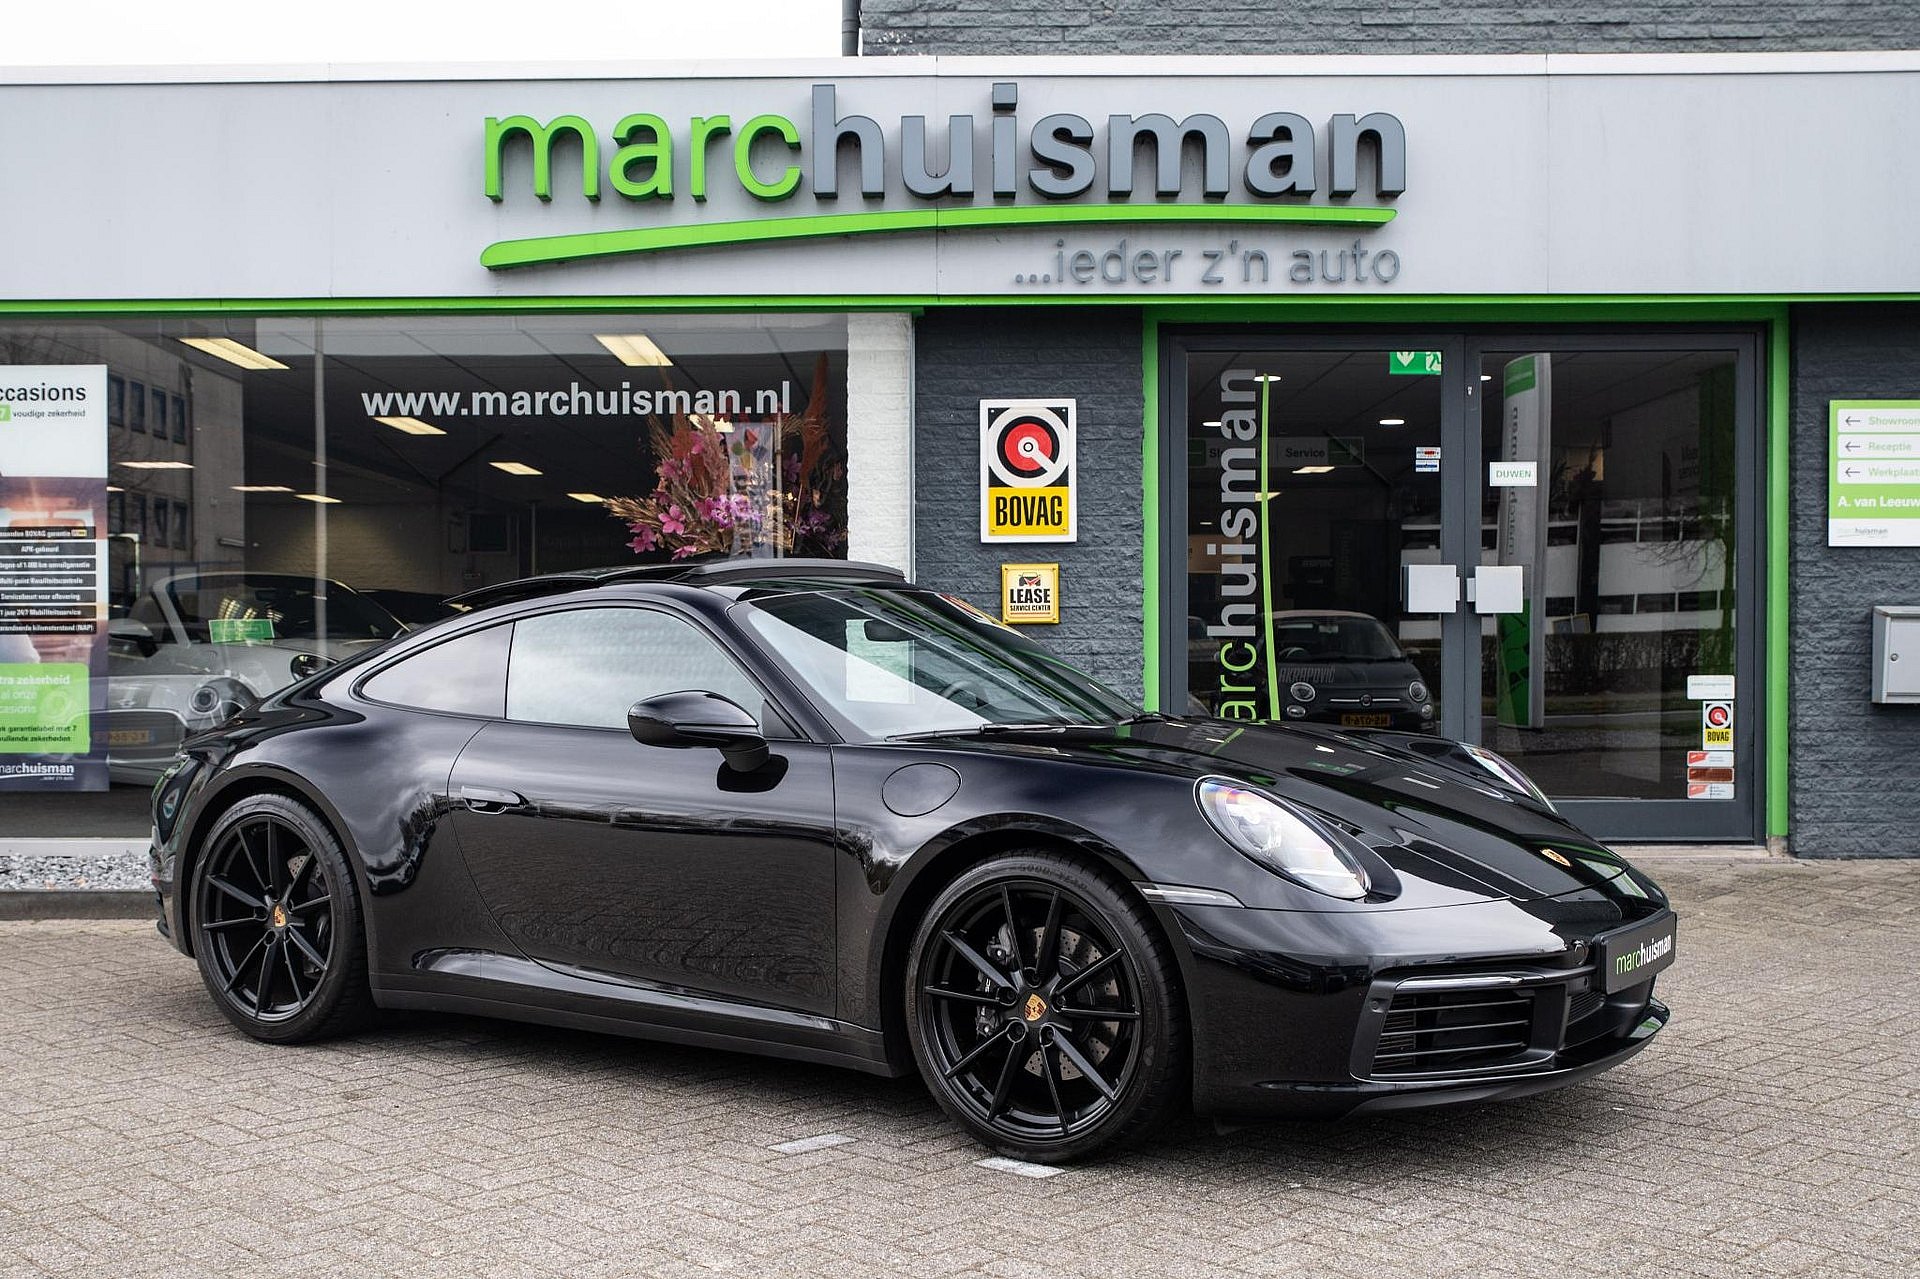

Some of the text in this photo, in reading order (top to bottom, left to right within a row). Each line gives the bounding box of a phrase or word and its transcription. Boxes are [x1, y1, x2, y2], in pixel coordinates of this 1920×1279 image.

[484, 83, 1406, 202] marchuisman
[1201, 239, 1269, 284] z'n
[1289, 238, 1400, 283] auto
[361, 381, 791, 416] www.marchuisman.nl
[1285, 449, 1325, 459] Service
[1868, 442, 1912, 453] Receptie
[1495, 470, 1532, 478] DUWEN
[1868, 467, 1920, 478] Werkplaat
[1838, 496, 1851, 507] A.
[1854, 498, 1876, 507] van
[995, 495, 1063, 527] BOVAG
[1206, 369, 1258, 720] archuisman
[1010, 589, 1051, 604] LEASE
[1010, 604, 1051, 612] SERVICE CENTER
[1707, 731, 1730, 742] BOVAG
[1616, 934, 1672, 975] marchuisman
